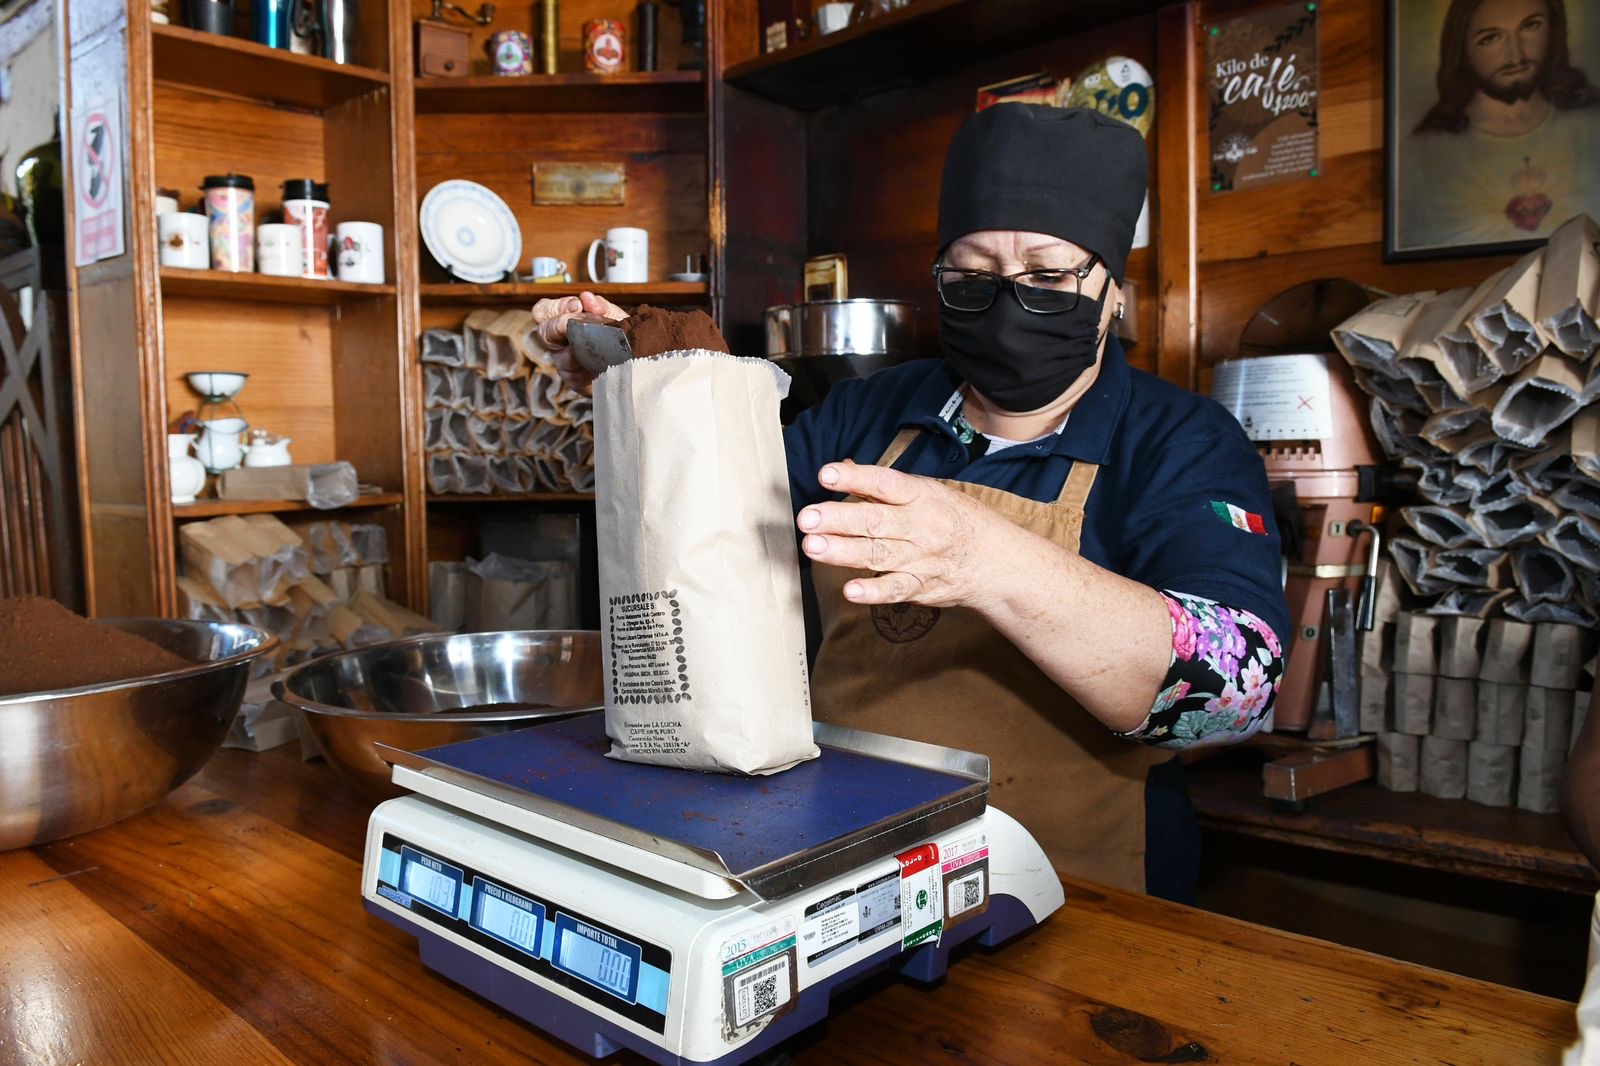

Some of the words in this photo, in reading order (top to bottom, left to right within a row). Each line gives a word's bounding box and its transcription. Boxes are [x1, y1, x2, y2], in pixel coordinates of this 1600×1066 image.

[1216, 58, 1247, 78] Kilo
[1250, 53, 1270, 71] de
[421, 855, 432, 868] PESO
[431, 862, 442, 873] NETO
[943, 845, 959, 860] 2017
[485, 883, 501, 898] PRECIO
[505, 892, 533, 912] KILOGRAMO
[577, 923, 601, 942] IMPORTE
[600, 934, 618, 950] TOTAL
[725, 938, 747, 959] 2015
